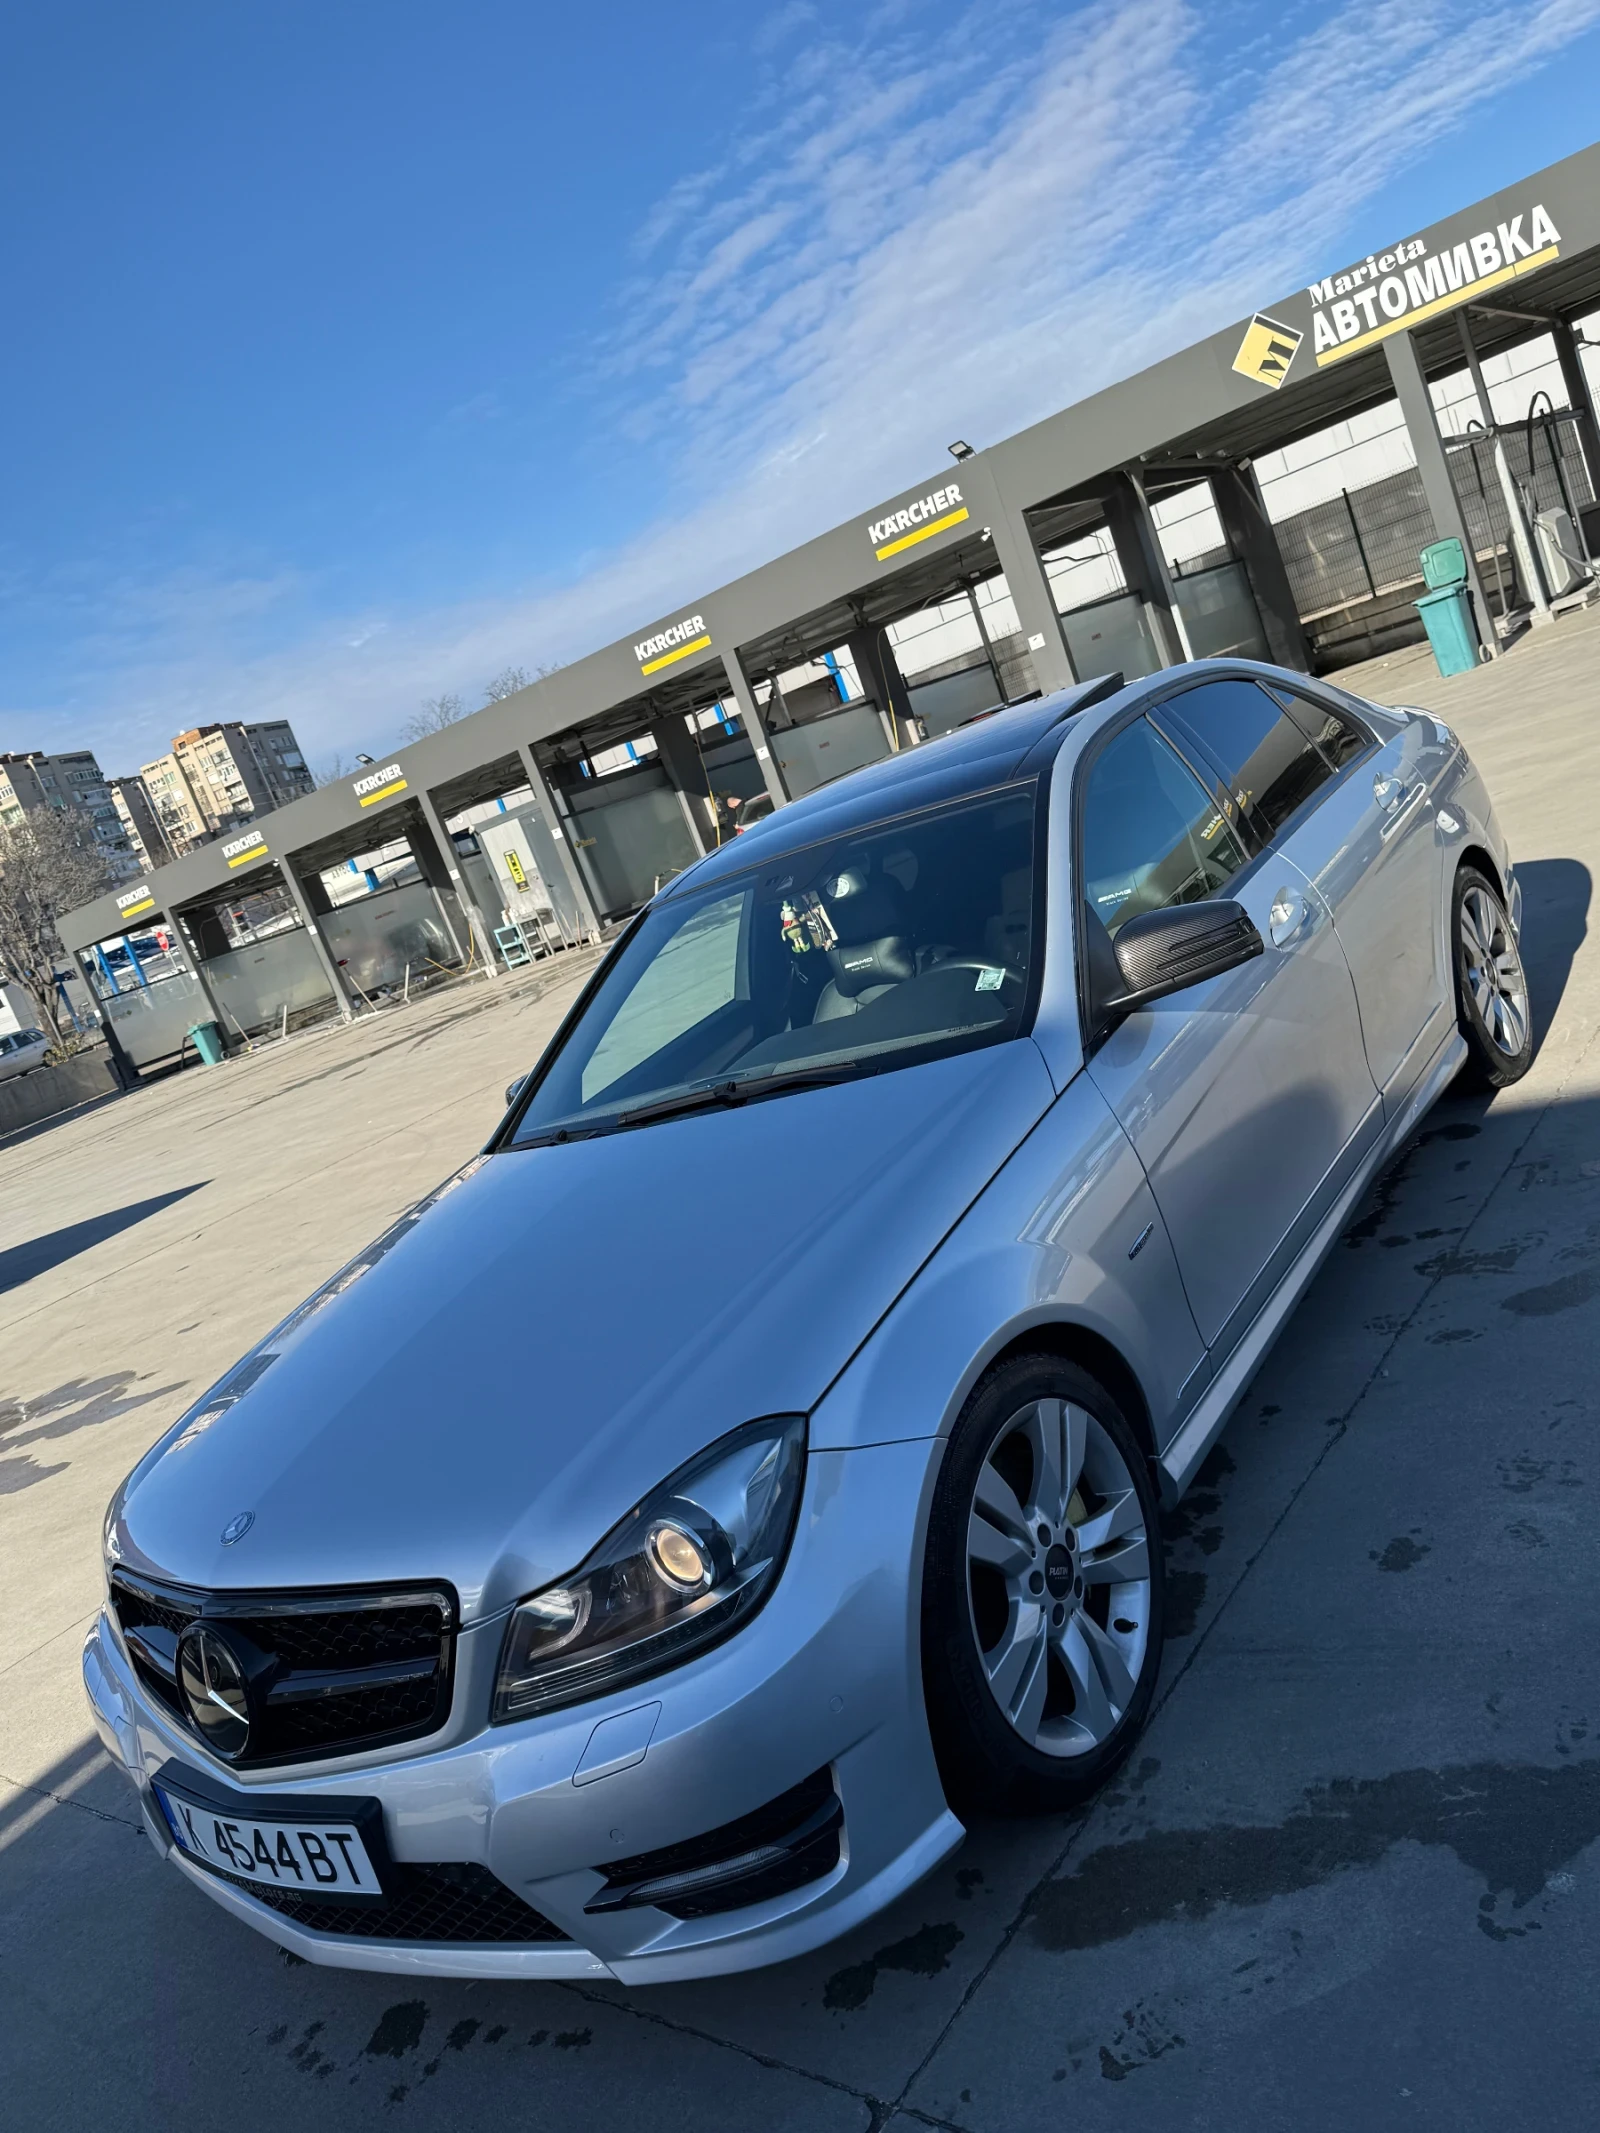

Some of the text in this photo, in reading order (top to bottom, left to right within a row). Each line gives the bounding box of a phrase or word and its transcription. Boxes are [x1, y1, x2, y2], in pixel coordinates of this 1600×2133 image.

[1307, 238, 1427, 308] Marieta
[1312, 204, 1562, 355] АВТОМИВКА
[868, 484, 964, 544] KÄRCHER
[634, 614, 706, 661] KÄRCHER
